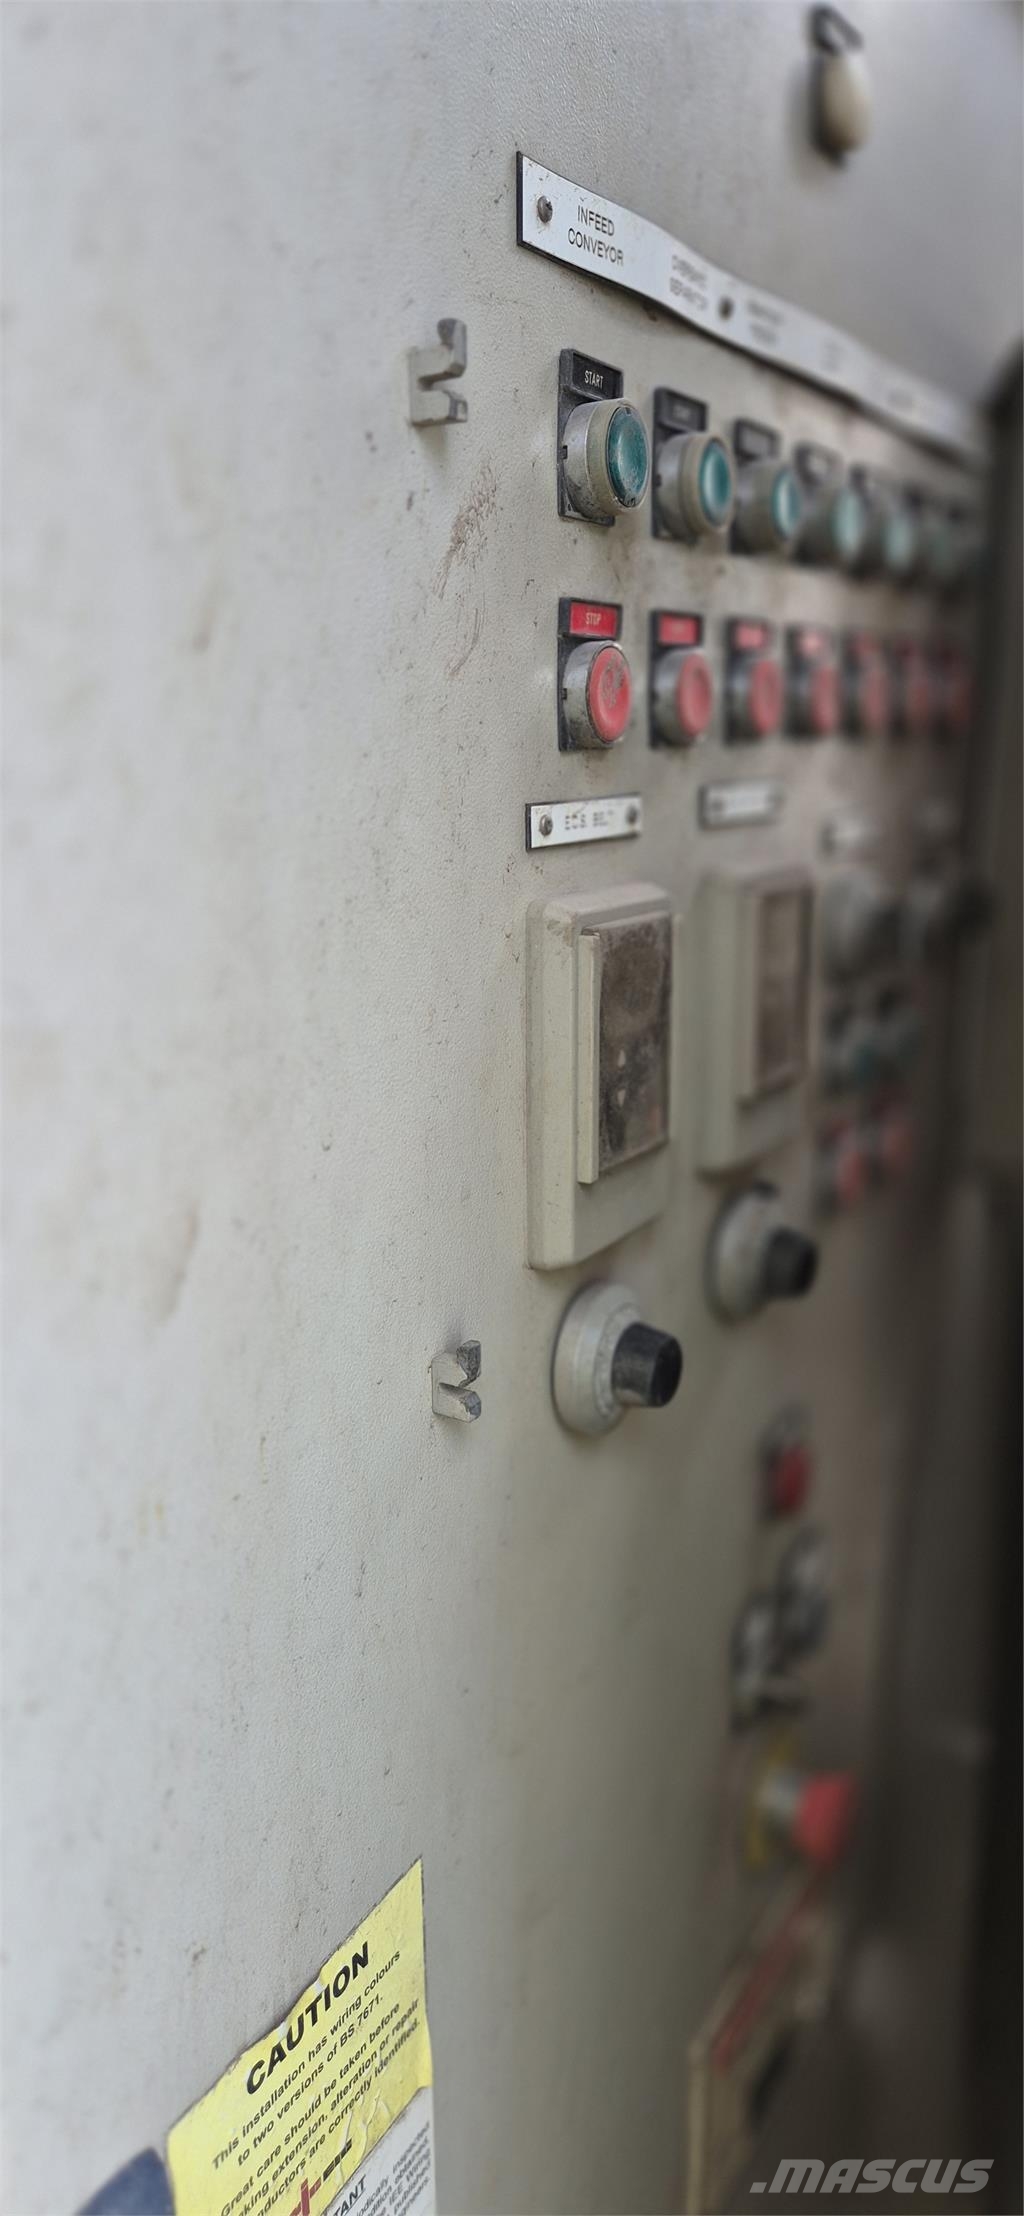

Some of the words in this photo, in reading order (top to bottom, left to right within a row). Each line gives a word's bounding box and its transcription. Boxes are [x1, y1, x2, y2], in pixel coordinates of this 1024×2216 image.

[567, 227, 625, 267] CONVEYOR
[577, 204, 615, 237] INFEED
[584, 370, 604, 389] START
[585, 612, 602, 626] STOP
[212, 2136, 240, 2170] This
[242, 2061, 306, 2139] installation
[308, 2035, 328, 2062] has
[329, 1995, 362, 2036] wiring
[364, 1950, 401, 1997] colours
[246, 1940, 369, 2095] CAUTION
[221, 2175, 255, 2216] Great
[256, 2144, 282, 2178] care
[284, 2094, 322, 2146] should
[324, 2078, 337, 2099] be
[339, 2042, 367, 2079] taken
[369, 2003, 400, 2044] before
[237, 2148, 250, 2167] to
[252, 2119, 275, 2149] two
[276, 2062, 324, 2119] versions
[326, 2042, 338, 2062] of
[340, 2023, 355, 2048] BS
[356, 1994, 383, 2026] 7671.
[272, 2114, 328, 2182] extension,
[330, 2050, 378, 2112] alteration
[379, 2034, 390, 2052] or
[391, 1998, 419, 2037] repair
[308, 2134, 326, 2159] are
[328, 2076, 372, 2134] correctly
